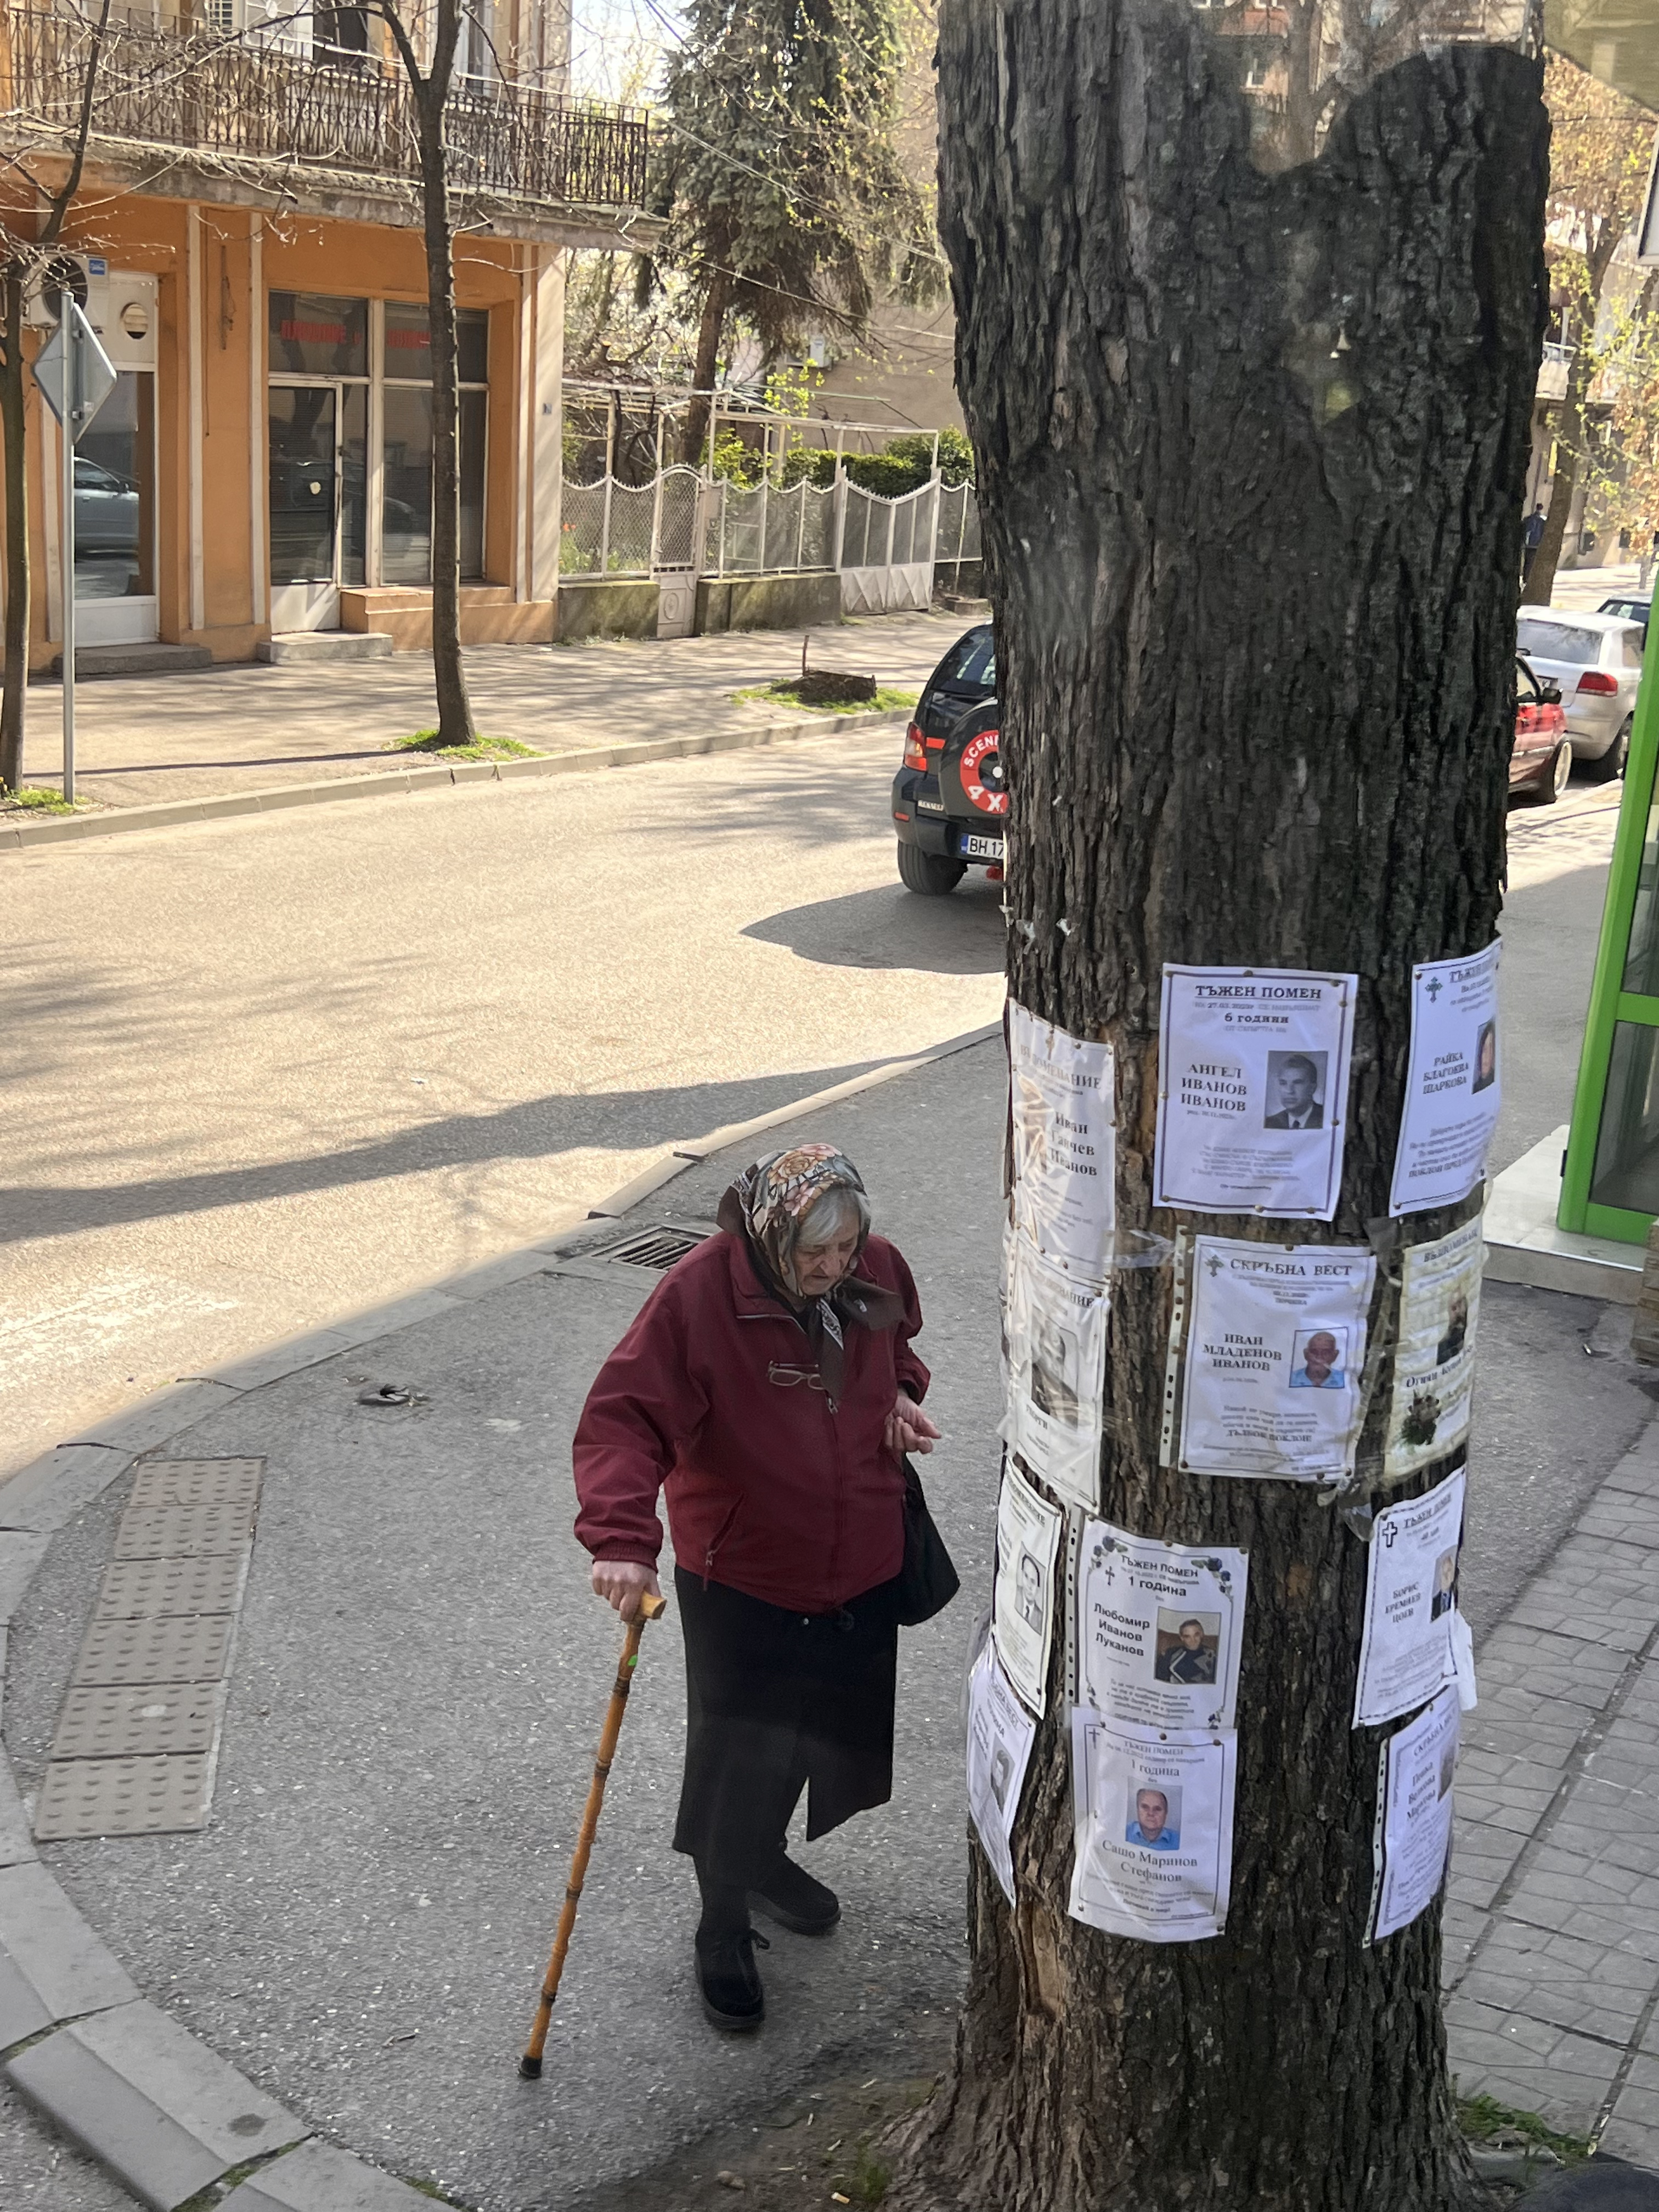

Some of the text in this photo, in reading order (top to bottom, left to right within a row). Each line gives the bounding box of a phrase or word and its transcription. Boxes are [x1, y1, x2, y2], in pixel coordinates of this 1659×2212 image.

[970, 838, 988, 854] BH
[1195, 986, 1321, 998] ТЪЖЕН ПОМЕН
[1186, 1064, 1242, 1079] АНГЕЛ
[1181, 1077, 1246, 1095] ИВАНОВ
[1181, 1093, 1246, 1111] ИВАНОВ
[1056, 1111, 1088, 1134] Иван
[1051, 1148, 1097, 1176] Иванов
[1231, 1259, 1352, 1276] СКРЪБНА ВЕСТ
[1224, 1333, 1263, 1345] ИВАН
[1203, 1344, 1282, 1360] МЛАДЕНОВ
[1212, 1358, 1270, 1371] ИВАНОВ
[1121, 1554, 1158, 1570] ТЪЖЕН
[1160, 1563, 1198, 1577] ПОМЕН
[1128, 1576, 1187, 1596] 1 година
[1094, 1602, 1150, 1630] Любомир
[1099, 1618, 1142, 1641] Иванов
[1096, 1632, 1144, 1656] Луканов
[1139, 1765, 1180, 1776] година
[1102, 1839, 1198, 1868] Сашо Маринов
[1121, 1861, 1182, 1882] Стефанов
